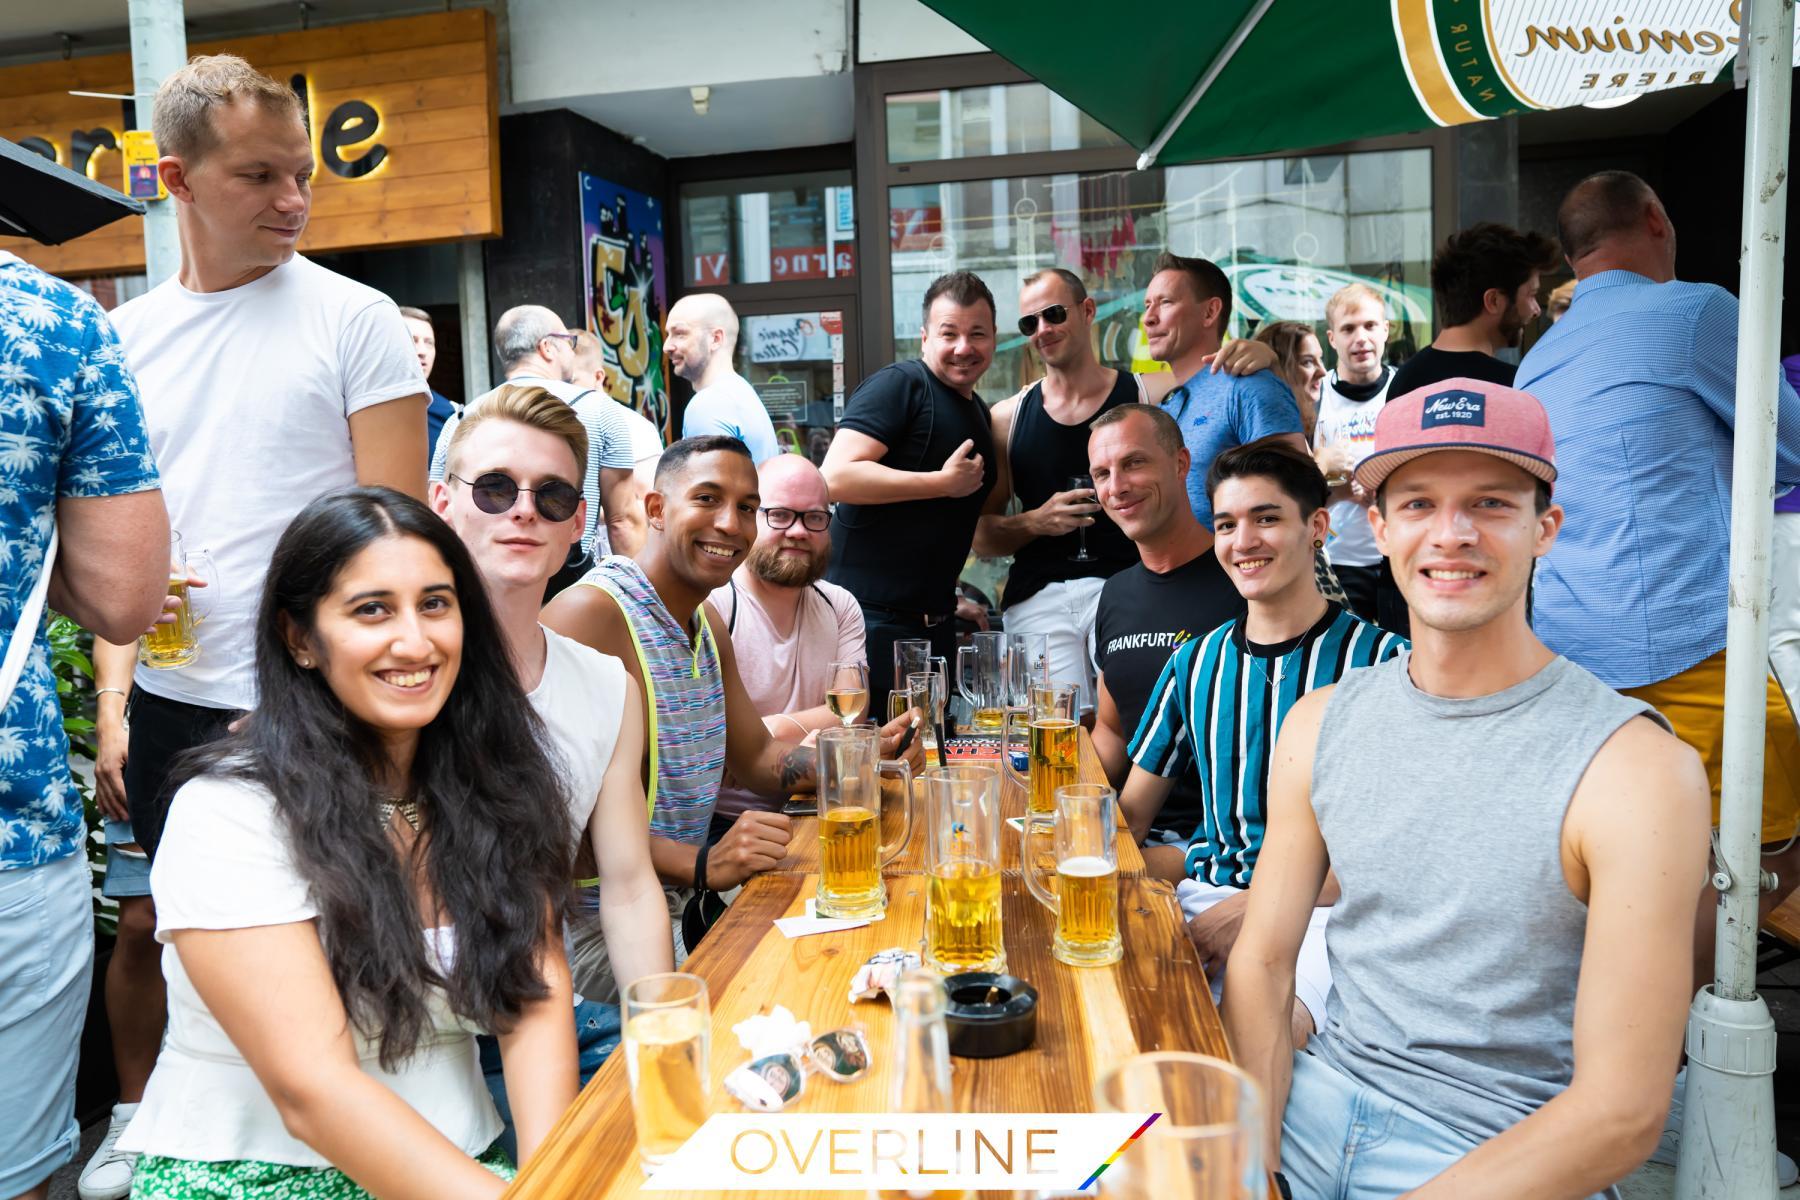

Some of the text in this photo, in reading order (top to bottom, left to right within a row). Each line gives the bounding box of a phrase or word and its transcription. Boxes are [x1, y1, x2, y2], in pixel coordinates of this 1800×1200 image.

[1425, 397, 1480, 414] New Era
[1452, 411, 1473, 419] 1920
